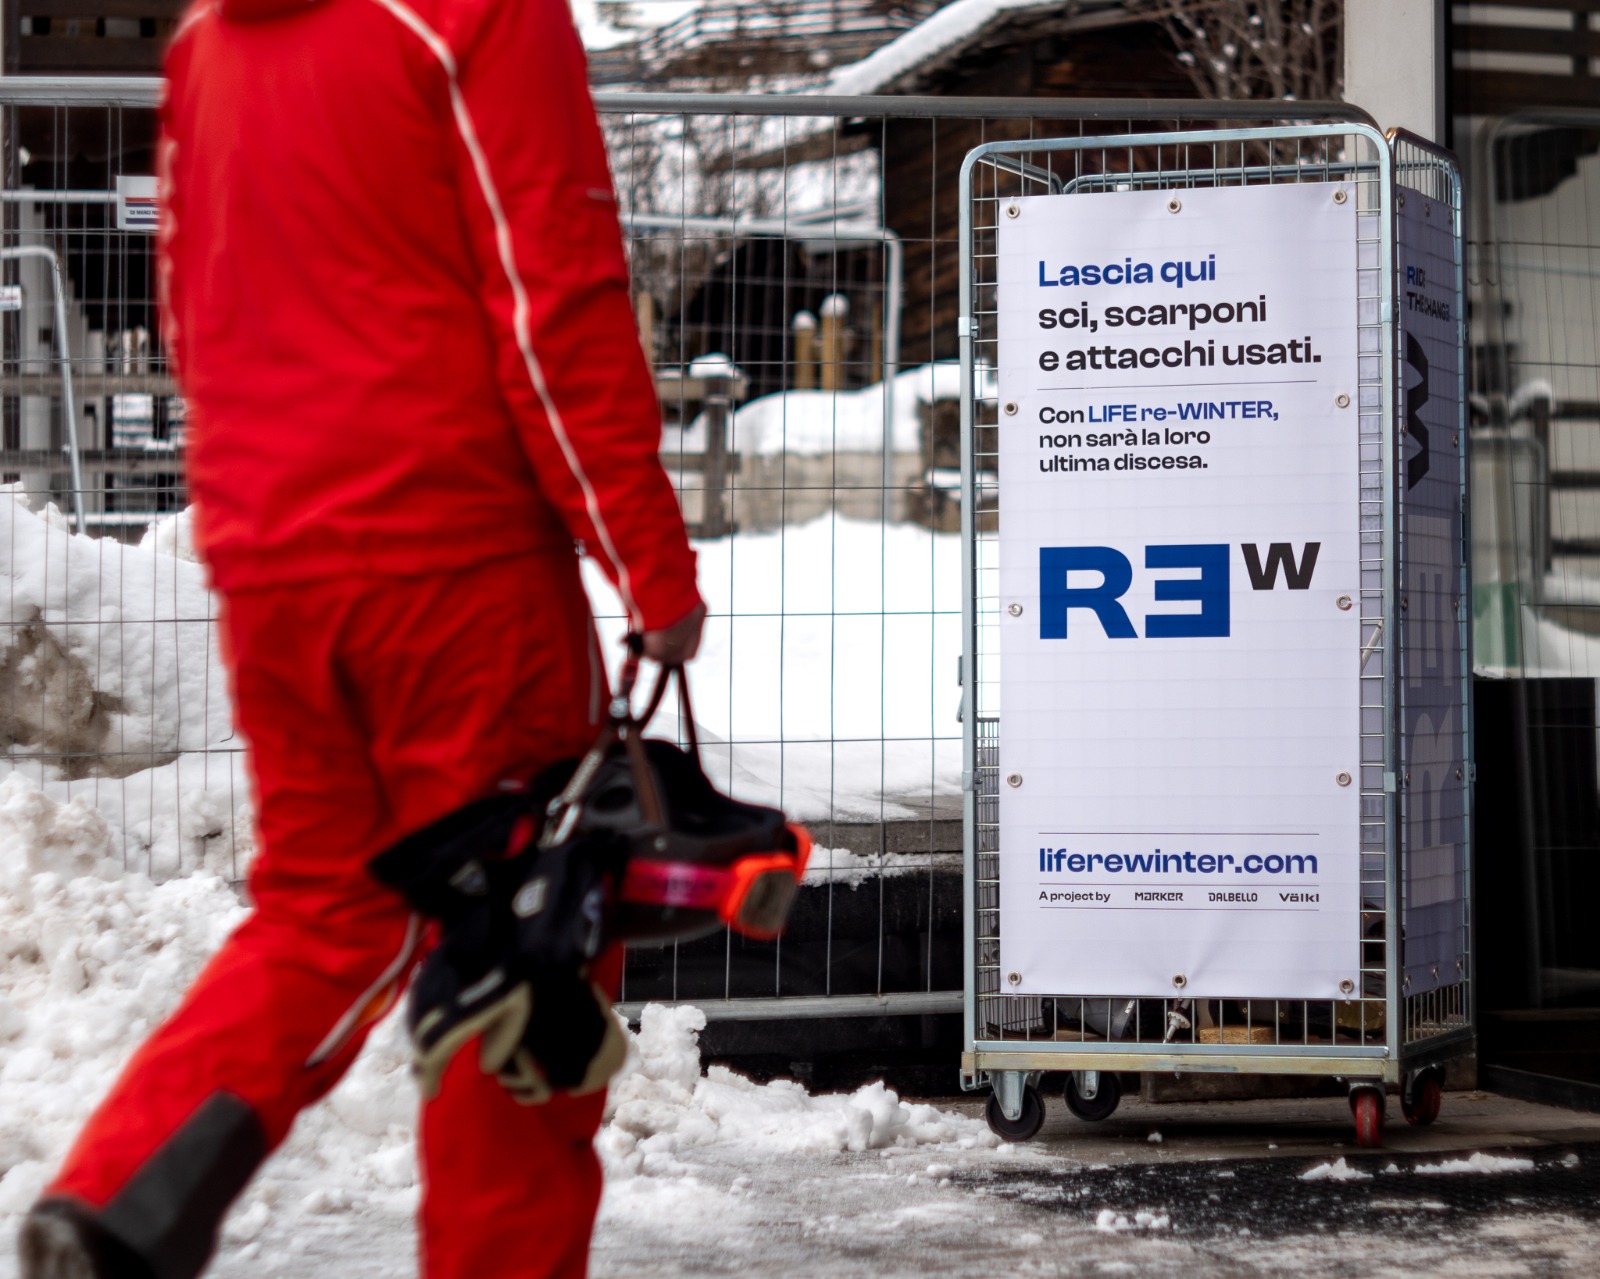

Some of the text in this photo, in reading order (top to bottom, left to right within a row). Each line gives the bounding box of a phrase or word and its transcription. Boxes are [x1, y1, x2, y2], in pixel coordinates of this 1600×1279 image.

[1039, 254, 1216, 288] Lascia qui
[1038, 295, 1266, 333] sci, scarponi
[1038, 336, 1322, 372] e attacchi usati.
[1038, 401, 1279, 424] Con LIFE re-WINTER,
[1039, 428, 1211, 448] non sarà la loro
[1039, 453, 1209, 473] ultima discesa.
[1039, 848, 1318, 874] liferewinter.com
[1038, 891, 1049, 901] A
[1050, 891, 1094, 903] project
[1095, 891, 1111, 903] by
[1208, 892, 1258, 902] DALBELLO
